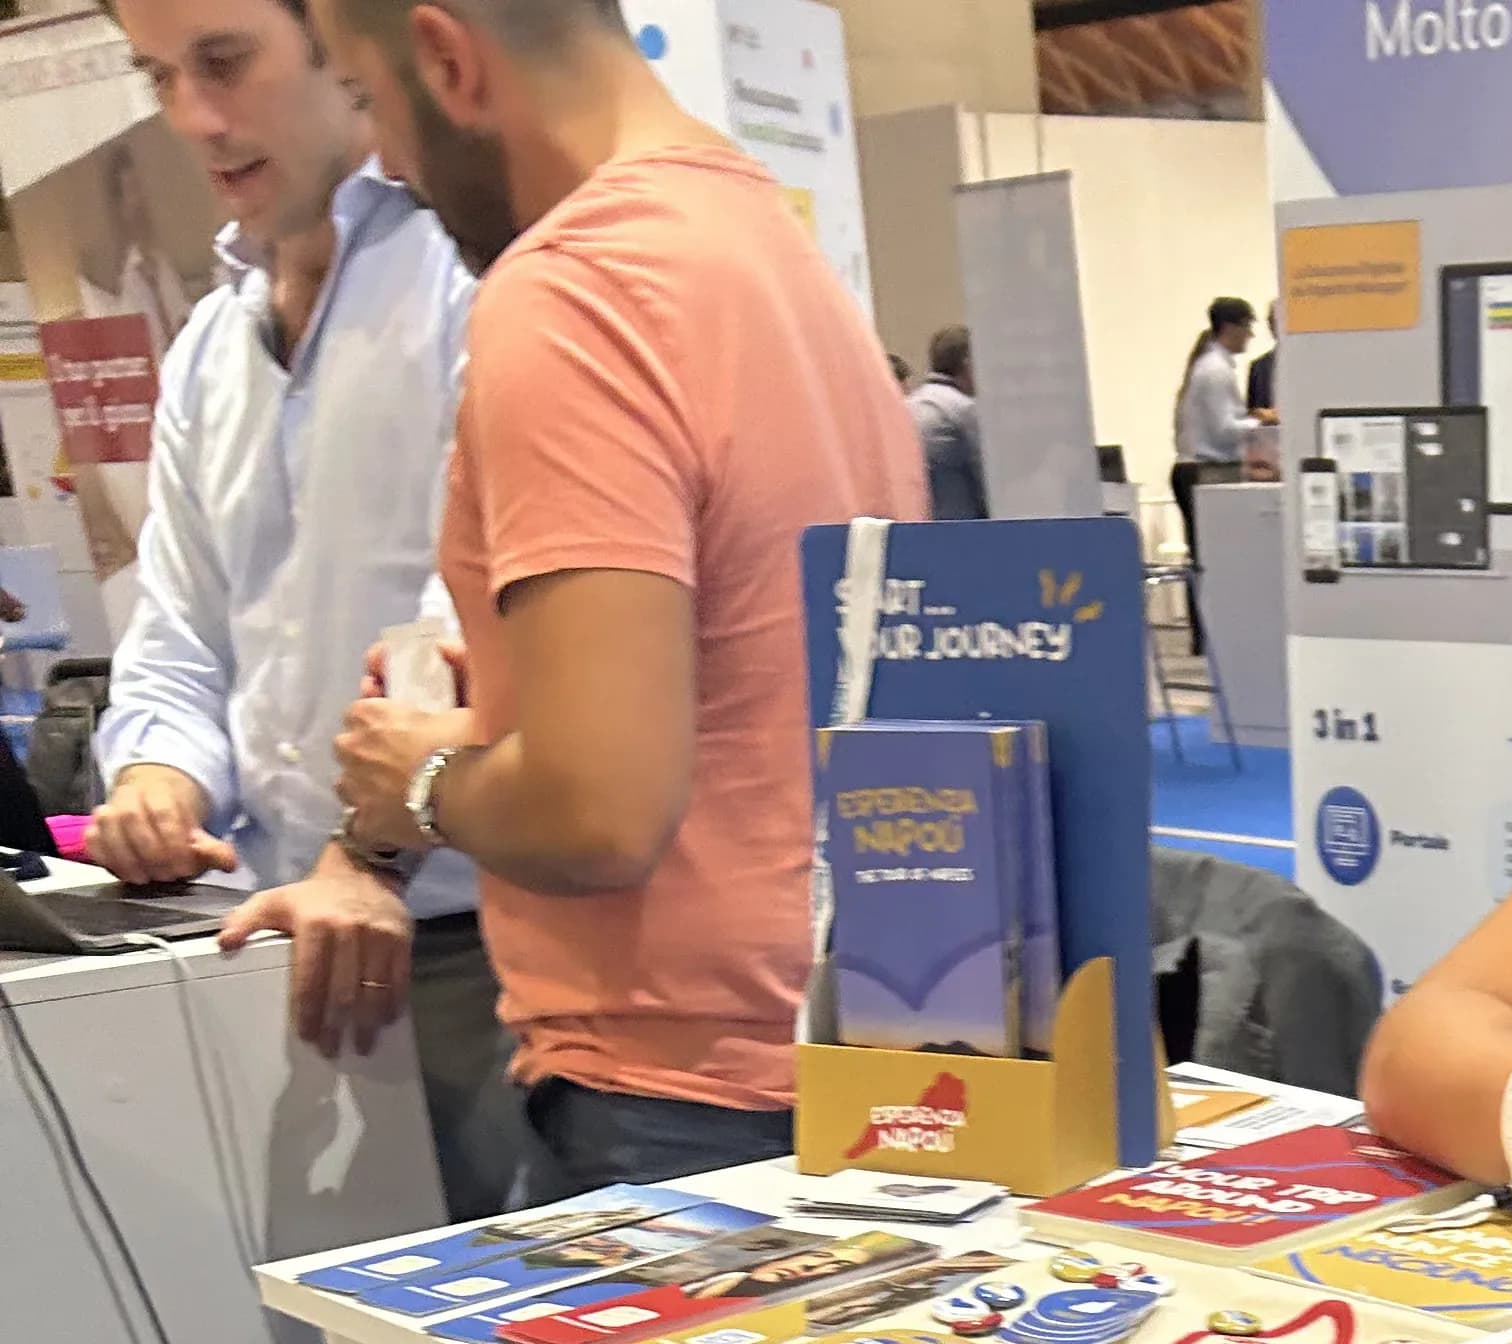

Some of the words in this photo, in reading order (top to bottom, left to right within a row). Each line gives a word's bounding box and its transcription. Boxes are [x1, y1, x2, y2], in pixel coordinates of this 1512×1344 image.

[1365, 0, 1511, 60] Molto
[924, 622, 1074, 661] JOURNEY
[1129, 1179, 1316, 1214] AROUND
[1150, 1164, 1277, 1193] YOUR
